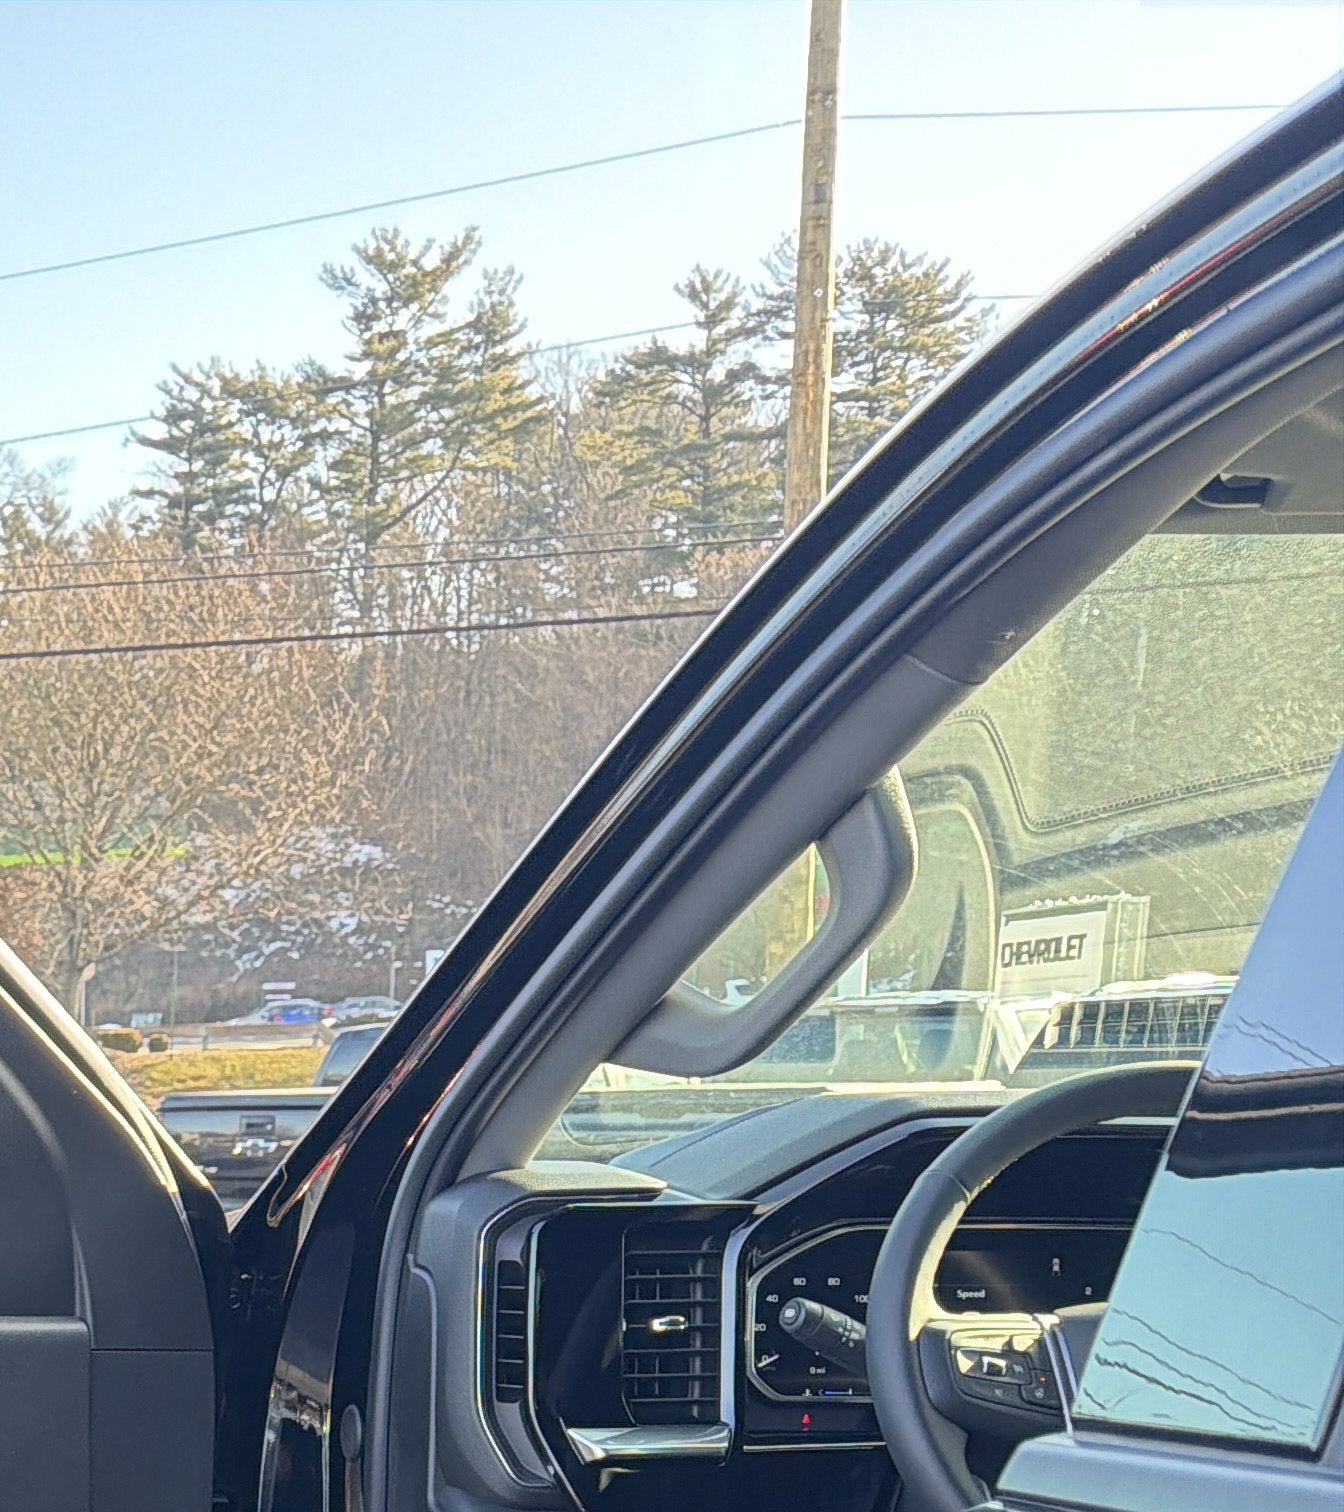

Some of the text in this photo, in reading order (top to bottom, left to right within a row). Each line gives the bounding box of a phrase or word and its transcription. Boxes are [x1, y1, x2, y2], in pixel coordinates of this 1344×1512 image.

[1001, 933, 1087, 968] CHEVROLET
[793, 1277, 807, 1286] 60
[827, 1277, 841, 1286] 80
[765, 1294, 779, 1303] 40
[956, 1289, 986, 1299] Speed
[753, 1323, 767, 1332] 20
